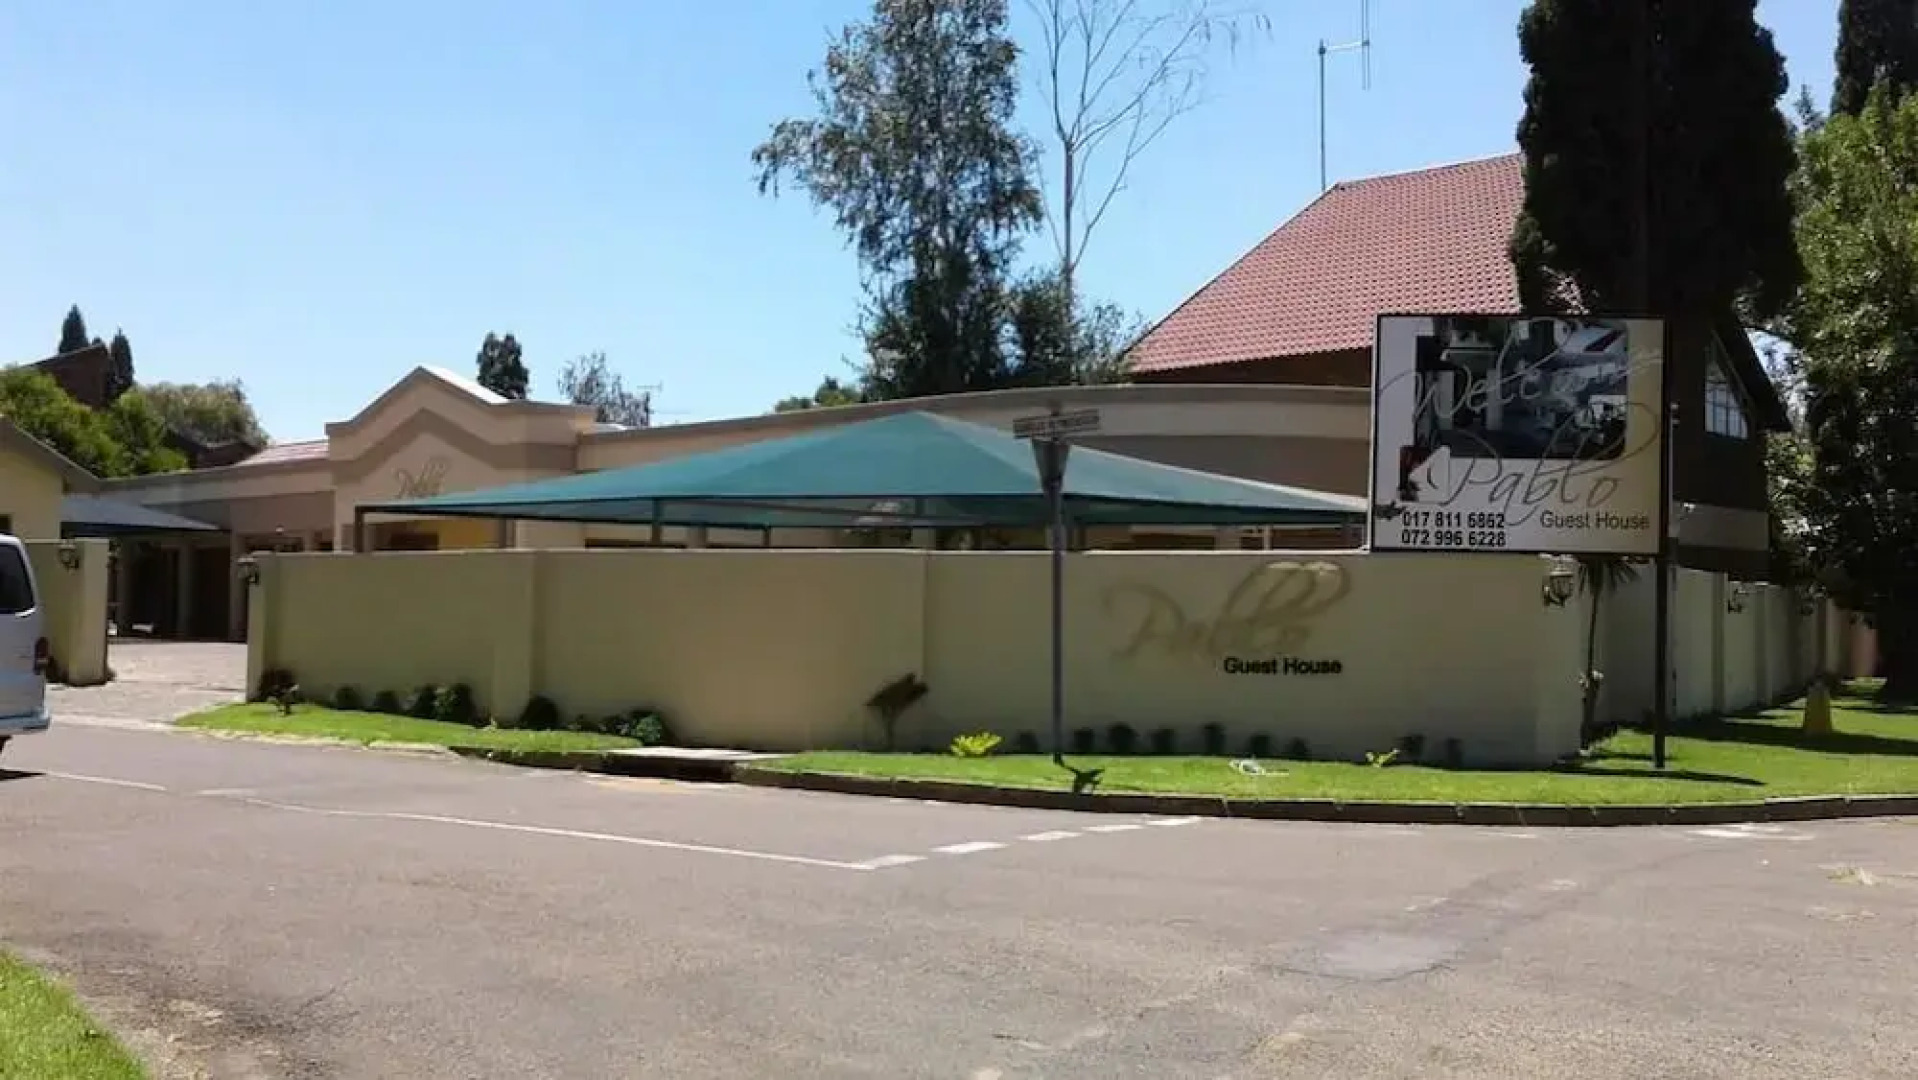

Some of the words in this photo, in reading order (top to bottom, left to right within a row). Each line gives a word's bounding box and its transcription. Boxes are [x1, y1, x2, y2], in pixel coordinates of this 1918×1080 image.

[1426, 402, 1660, 526] Pablo
[1402, 511, 1430, 527] 017
[1435, 511, 1462, 527] 811
[1540, 509, 1591, 529] Guest
[1595, 510, 1650, 530] House
[1401, 529, 1430, 545] 072
[1434, 530, 1463, 546] 996
[1468, 530, 1507, 547] 6228
[1104, 560, 1351, 660] Pablo
[1223, 656, 1278, 675] Guest
[1282, 656, 1343, 675] House
